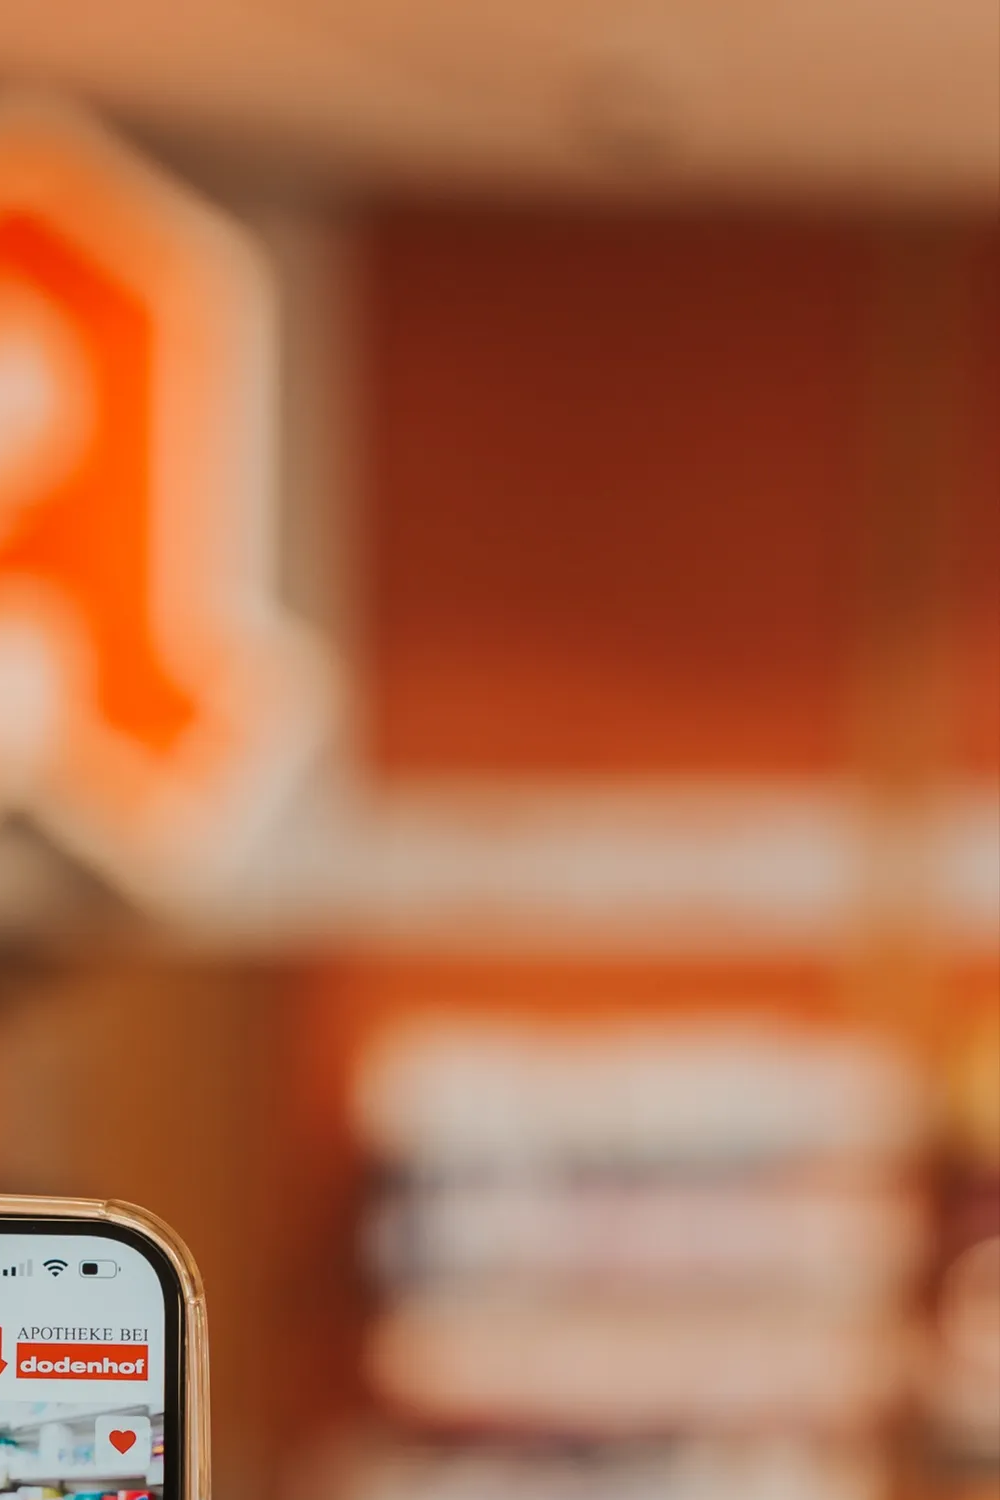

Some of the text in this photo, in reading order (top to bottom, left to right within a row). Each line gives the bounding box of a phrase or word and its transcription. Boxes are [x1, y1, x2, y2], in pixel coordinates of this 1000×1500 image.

[17, 1326, 148, 1342] APOTHEKE BEI
[19, 1355, 145, 1375] dodenhof
